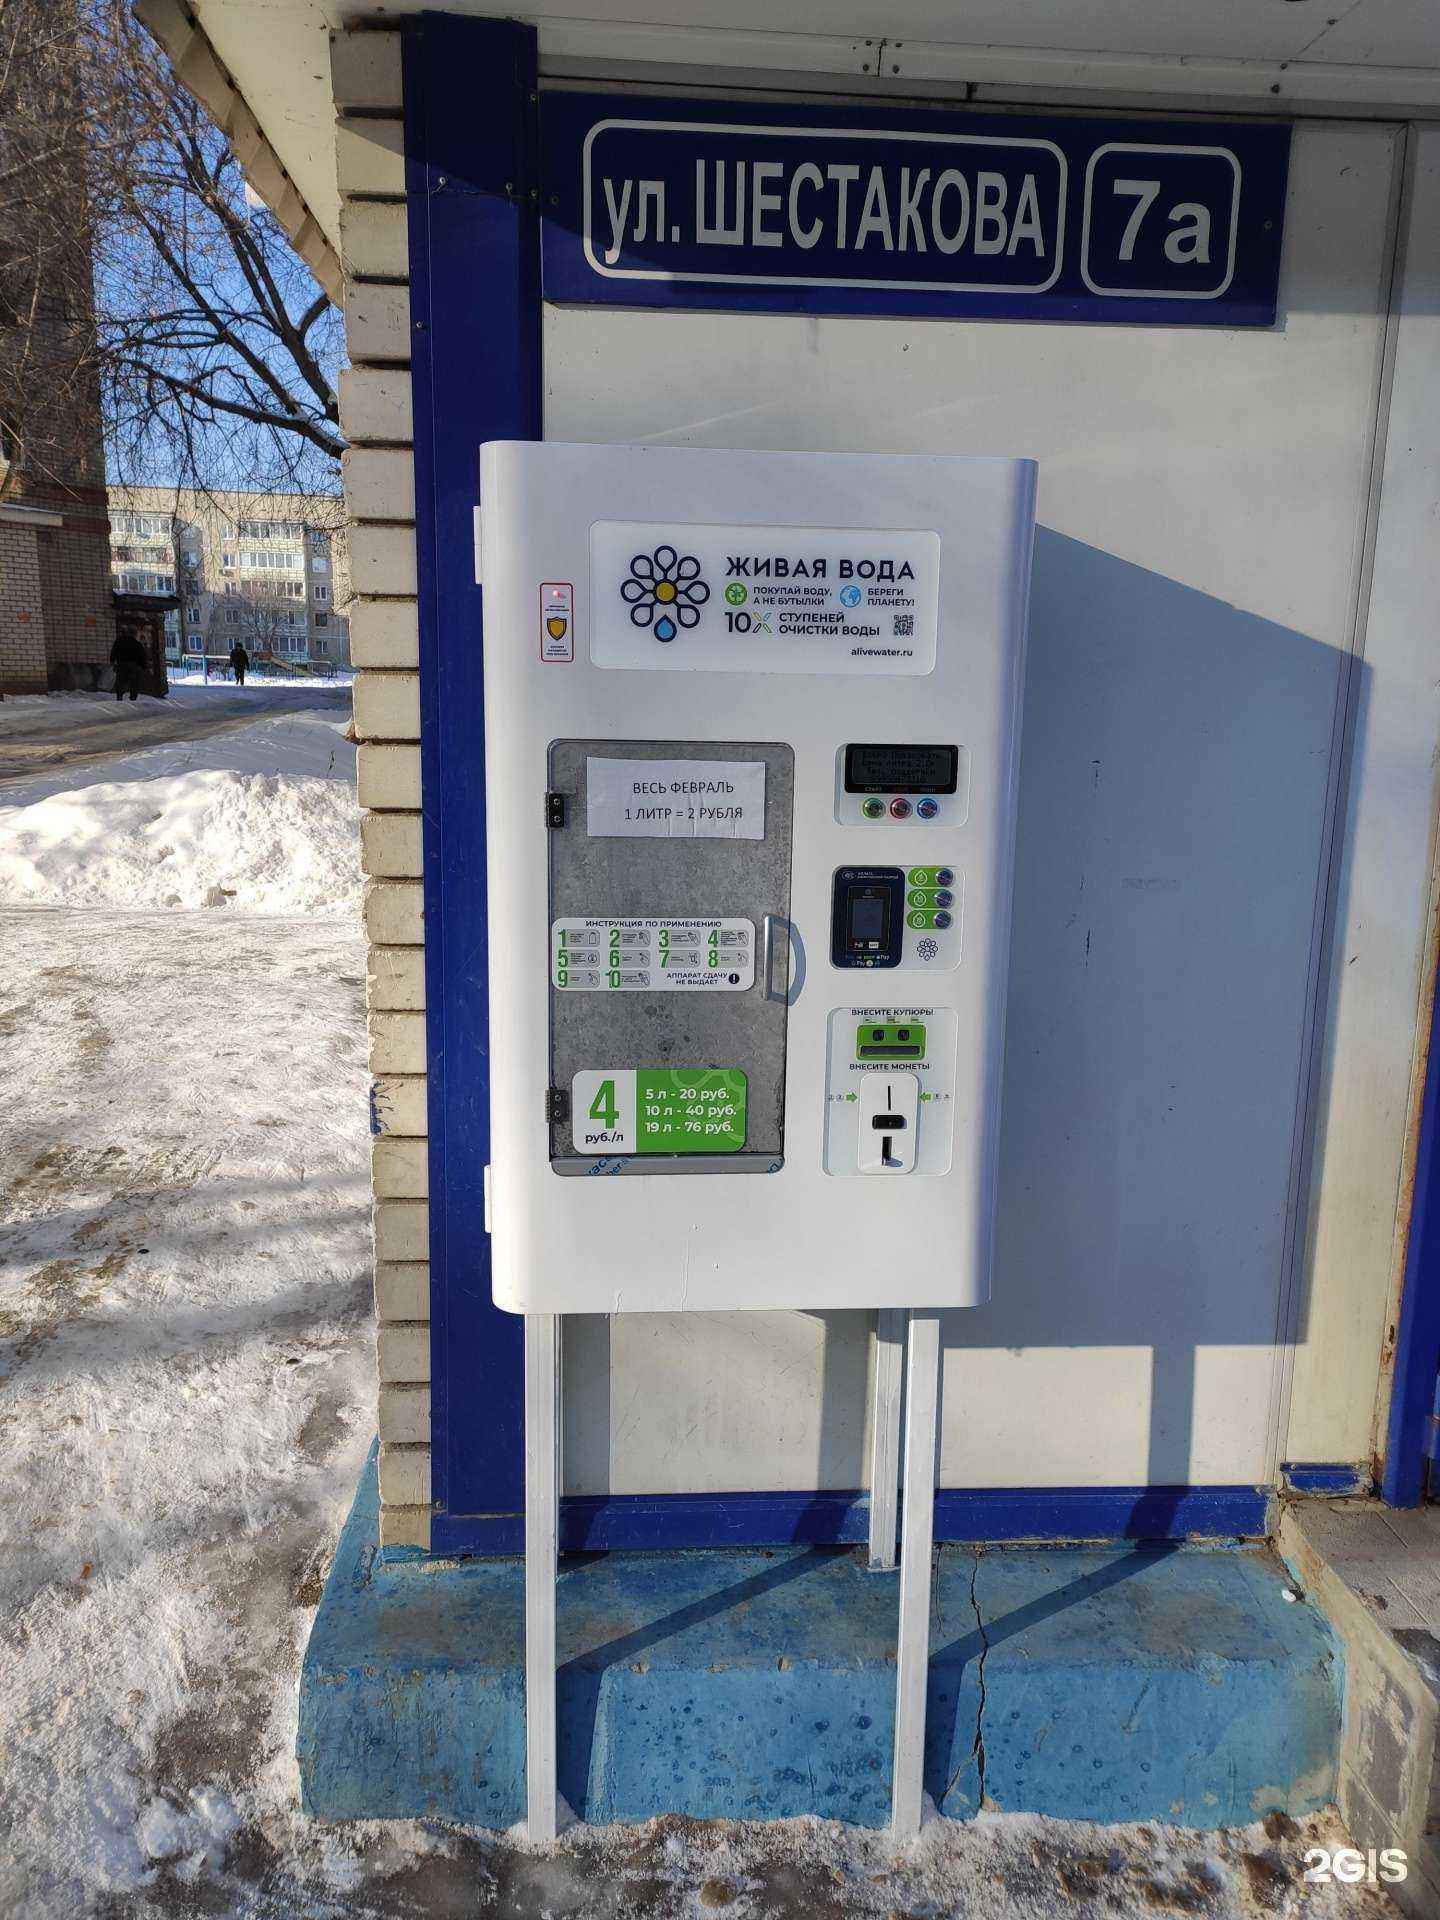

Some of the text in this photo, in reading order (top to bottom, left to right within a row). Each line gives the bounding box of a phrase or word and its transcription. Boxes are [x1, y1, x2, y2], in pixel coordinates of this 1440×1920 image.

[603, 159, 1046, 265] ул. ШЕСТАКОВА
[1112, 179, 1212, 265] 7а
[726, 556, 915, 583] ЖИВАЯ ВОДА
[753, 586, 832, 597] ПОКУПАЙ ВОДУ,
[867, 588, 904, 596] БЕРЕГИ
[753, 597, 760, 605] А
[778, 598, 825, 606] БУТЫЛКИ
[867, 599, 915, 607] ПЛАНЕТУ!
[779, 612, 845, 623] СТУПЕНЕЙ
[779, 625, 880, 637] ОЧИСТКИ ВОДЫ
[851, 647, 914, 657] alivewater.ru
[633, 781, 734, 794] ВЕСЬ ФЕВРАЛЬ
[624, 808, 632, 820] 1
[636, 808, 672, 820] ЛИТР
[688, 807, 695, 820] 2
[699, 807, 743, 819] РУБЛЯ
[585, 920, 643, 928] ИНСТРУКЦИЯ
[558, 929, 566, 947] 1
[609, 929, 620, 947] 2
[659, 929, 669, 948] 3
[707, 929, 719, 948] 4
[558, 949, 568, 968] 5
[609, 949, 620, 968] 6
[658, 949, 670, 968] 7
[708, 949, 719, 968] 8
[558, 969, 568, 988] 9
[604, 969, 621, 988] 10
[645, 1089, 654, 1100] 5
[656, 1091, 667, 1100] л
[679, 1089, 697, 1100] 20
[701, 1088, 730, 1102] руб.
[589, 1080, 620, 1130] 4
[645, 1106, 660, 1116] 10
[664, 1107, 673, 1116] л
[685, 1105, 704, 1116] 40
[708, 1105, 737, 1118] руб.
[645, 1122, 660, 1132] 19
[663, 1124, 672, 1132] л
[685, 1122, 702, 1132] 76
[705, 1121, 734, 1135] руб.
[585, 1131, 624, 1144] руб./л
